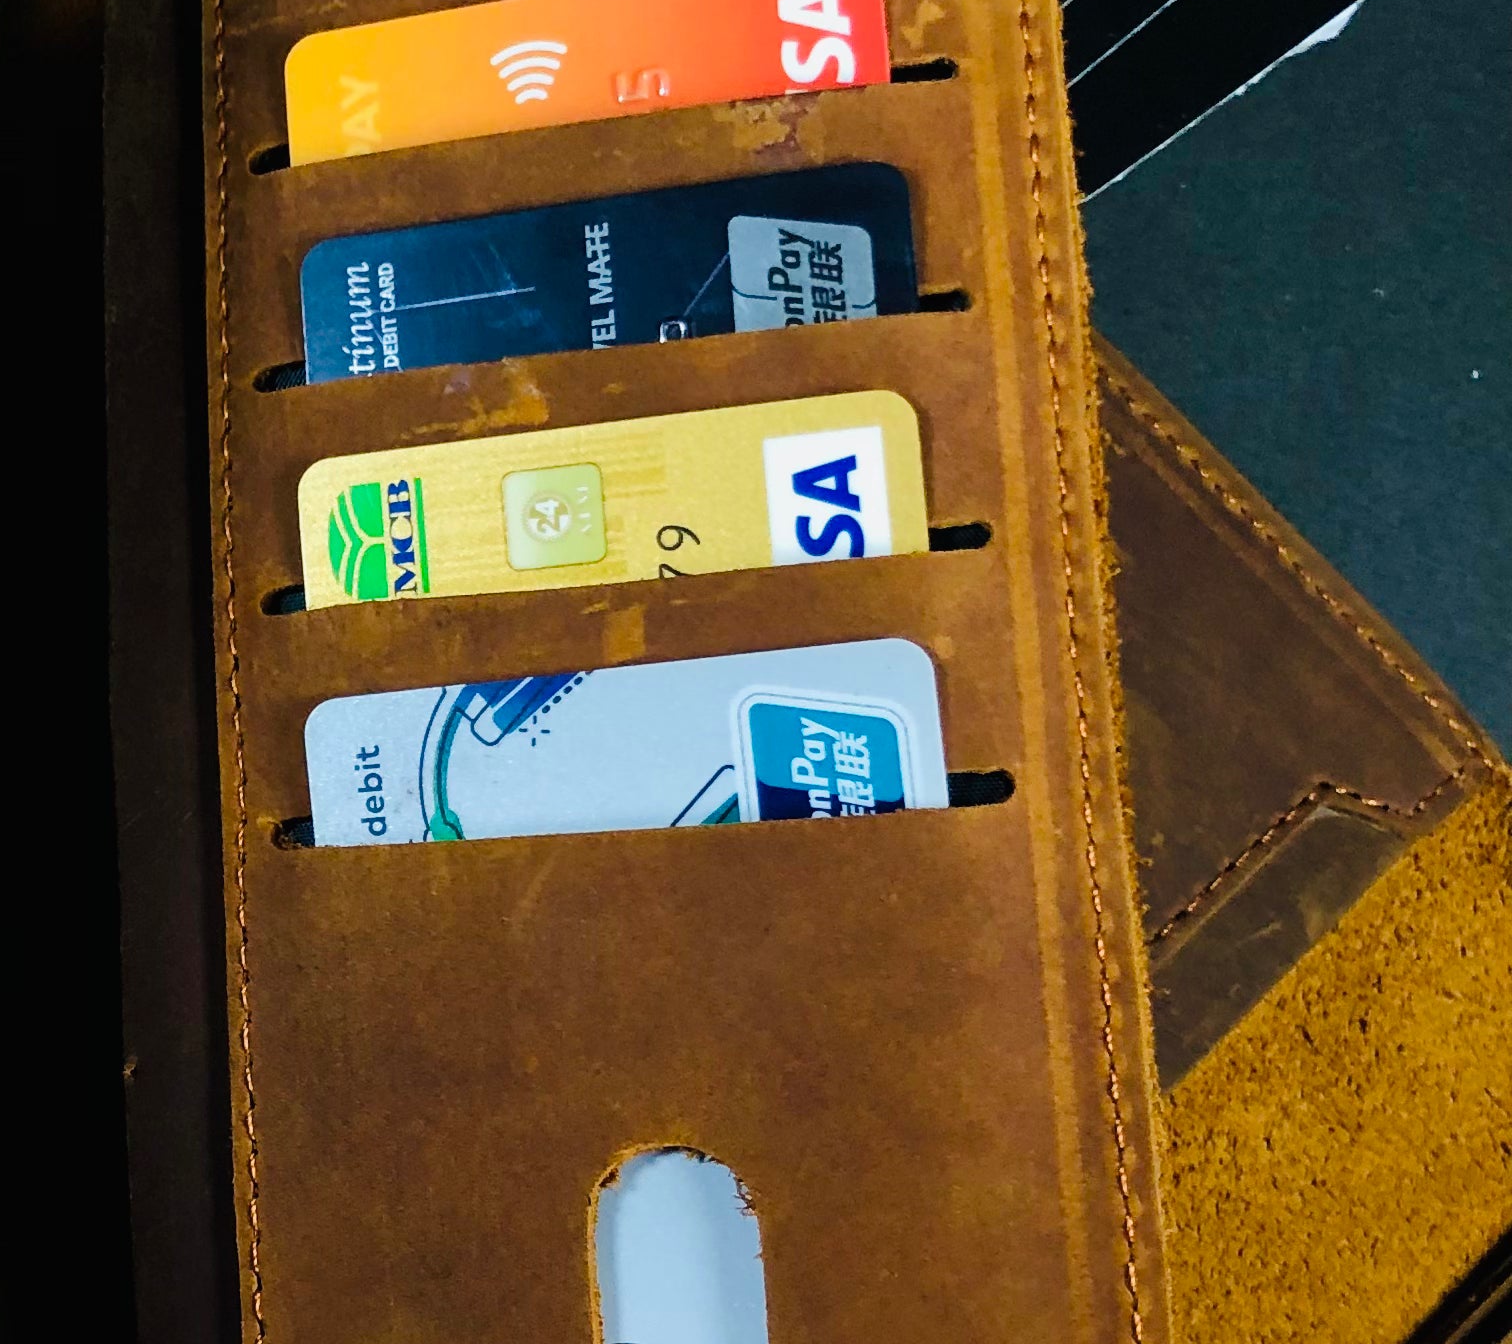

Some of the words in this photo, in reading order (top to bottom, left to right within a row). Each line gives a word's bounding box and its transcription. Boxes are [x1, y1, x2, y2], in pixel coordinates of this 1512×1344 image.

[377, 261, 397, 313] CARD
[584, 221, 615, 306] MATE
[341, 261, 377, 378] tinum
[380, 315, 401, 369] DEBIT
[388, 479, 419, 596] MCB
[357, 744, 388, 837] debit
